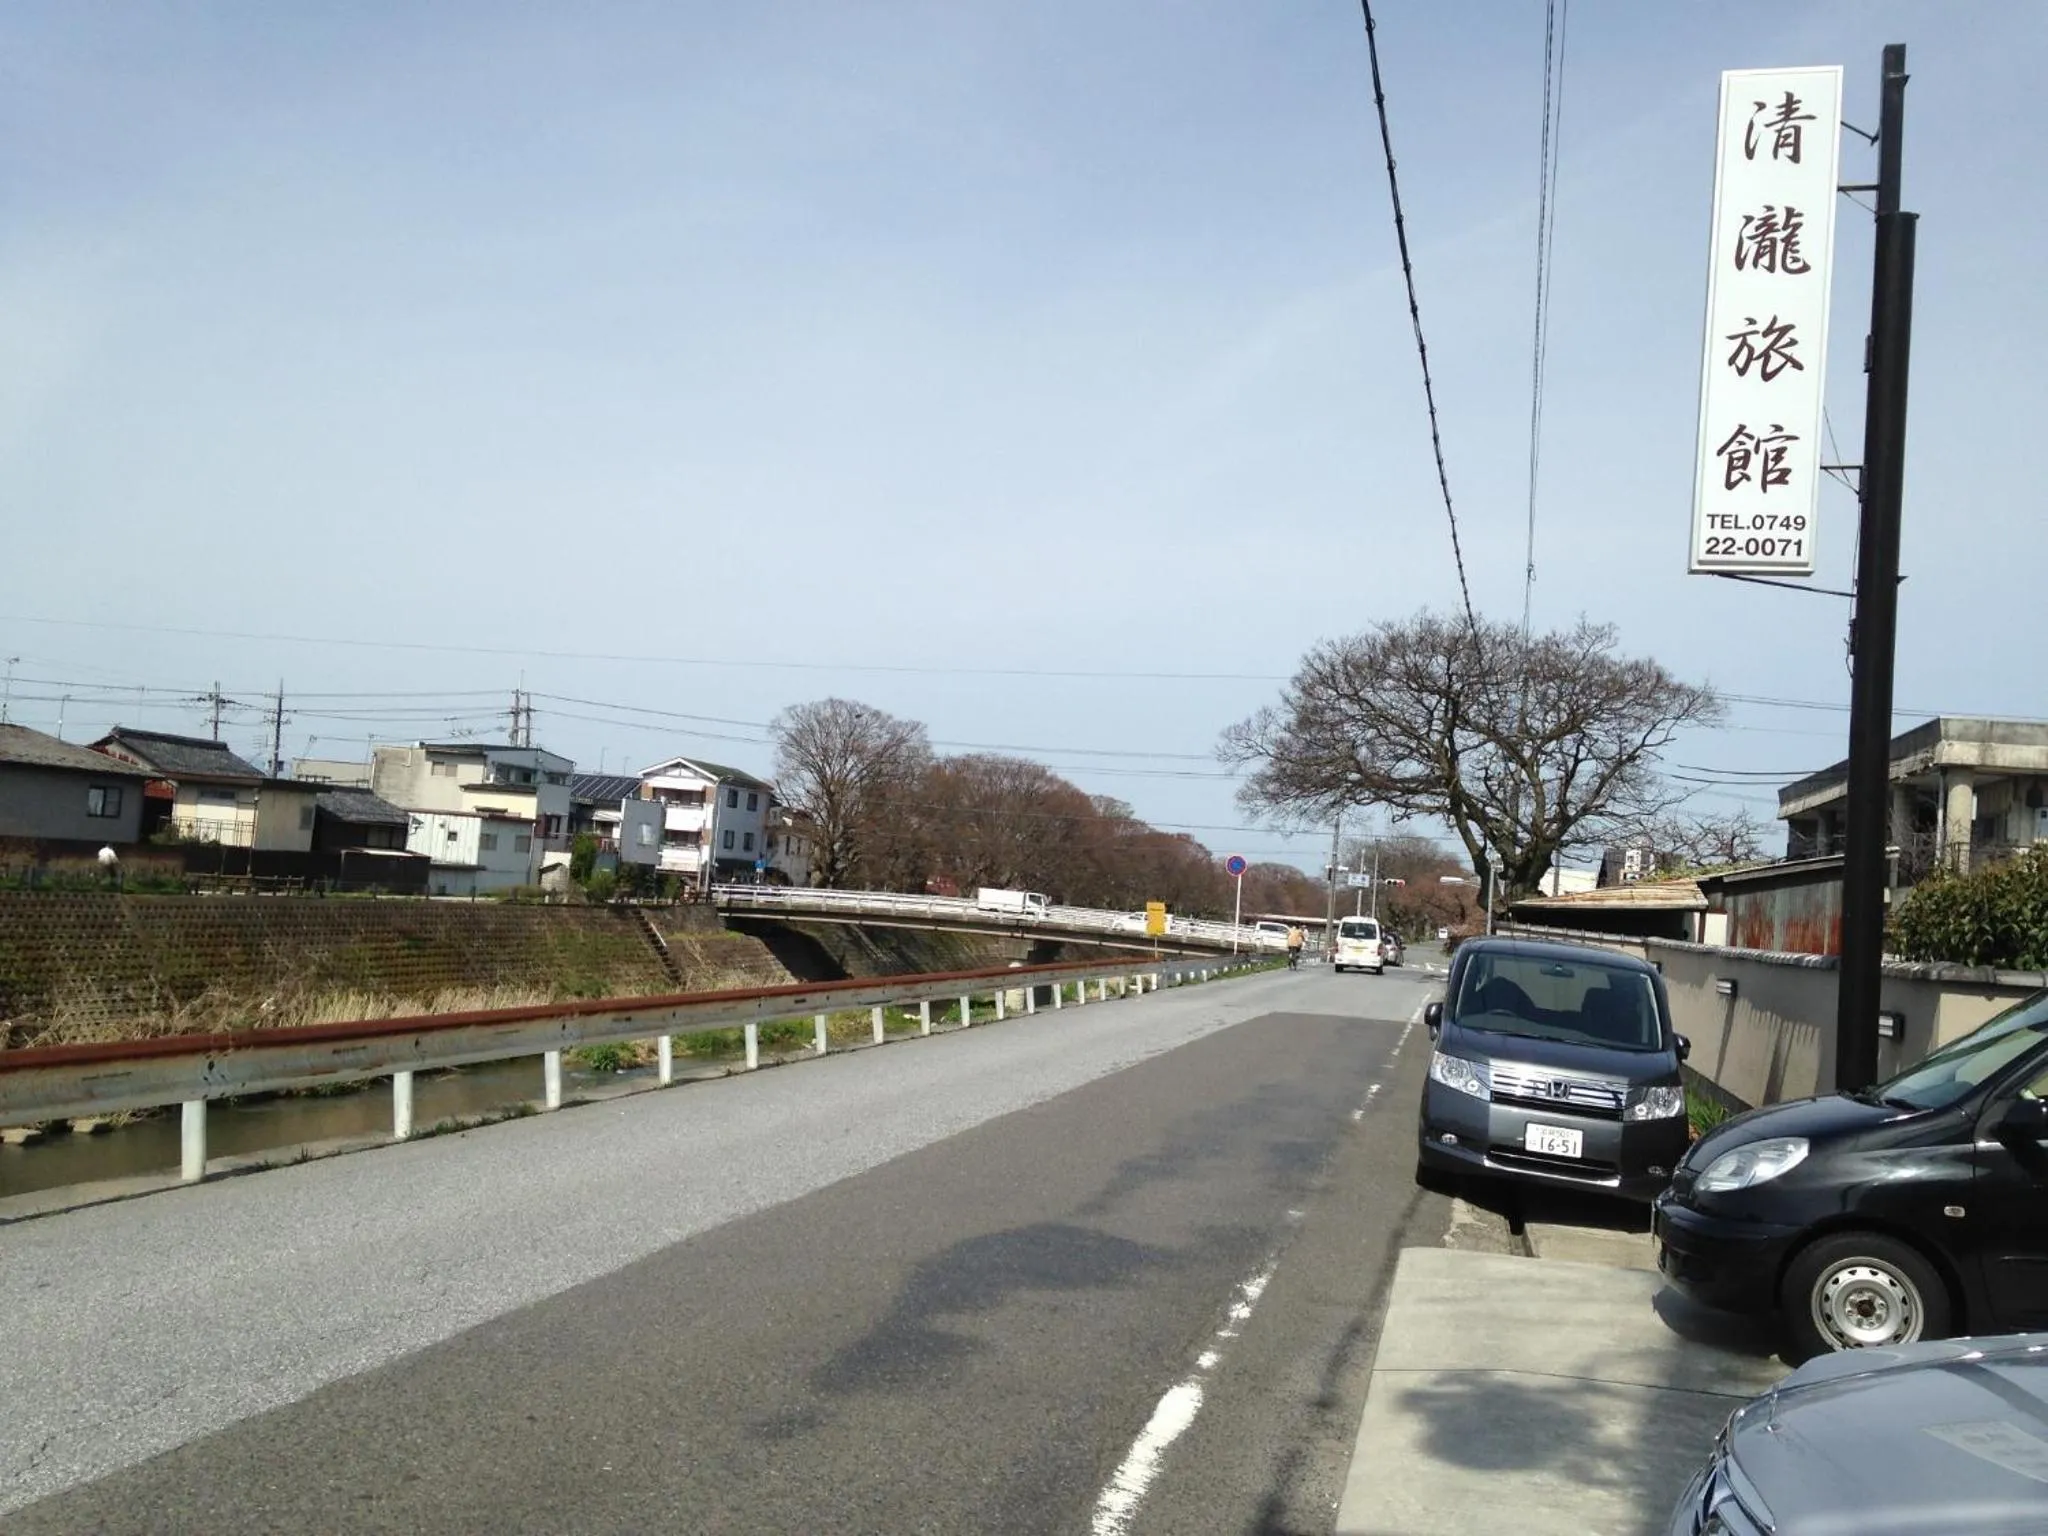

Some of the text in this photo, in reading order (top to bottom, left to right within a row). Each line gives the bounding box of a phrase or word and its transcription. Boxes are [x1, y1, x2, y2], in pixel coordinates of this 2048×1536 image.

[1717, 91, 1817, 494] 清瀧旅館
[1706, 514, 1806, 531] TEL.0749
[1705, 537, 1803, 557] 22-0071
[1540, 1137, 1577, 1155] 16-51
